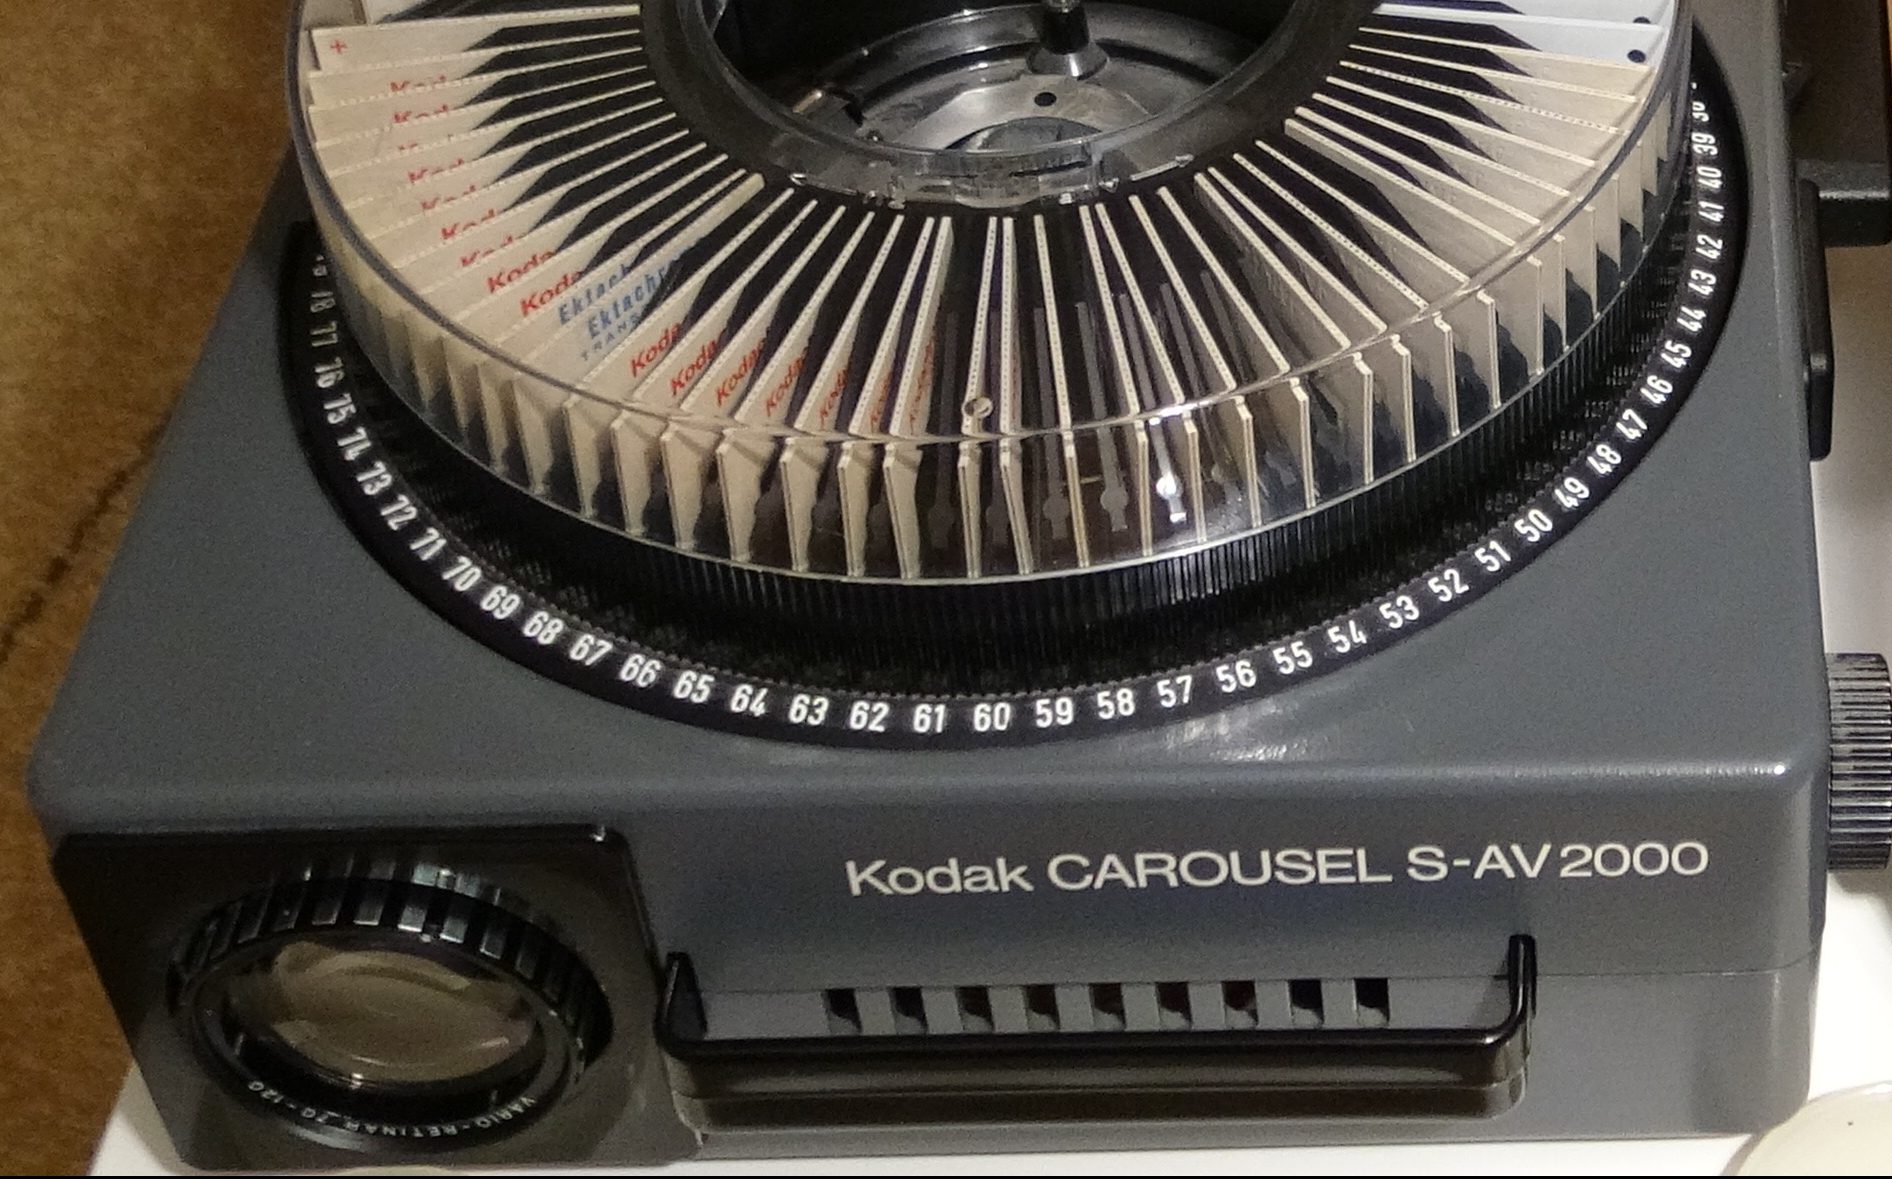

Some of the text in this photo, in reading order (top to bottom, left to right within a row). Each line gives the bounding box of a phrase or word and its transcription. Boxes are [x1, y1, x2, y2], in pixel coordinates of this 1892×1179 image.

[1691, 131, 1718, 156] 39
[1696, 165, 1723, 189] 40
[1698, 200, 1724, 222] 41
[1695, 234, 1723, 260] 42
[1687, 268, 1717, 296] 43
[1676, 306, 1707, 332] 44
[1660, 339, 1692, 369] 45
[1640, 374, 1673, 404] 46
[323, 393, 356, 424] 75
[1615, 408, 1648, 440] 47
[337, 426, 372, 461] 74
[1587, 443, 1622, 475] 48
[356, 461, 393, 496] 73
[1554, 476, 1590, 509] 49
[380, 494, 418, 531] 72
[1513, 508, 1553, 542] 50
[410, 527, 447, 561] 71
[1474, 540, 1511, 572] 51
[442, 555, 482, 592] 70
[1427, 568, 1470, 602] 52
[480, 585, 521, 620] 69
[1378, 595, 1420, 629] 53
[523, 610, 564, 645] 68
[1327, 619, 1367, 653] 54
[569, 633, 613, 666] 67
[1272, 640, 1313, 675] 55
[619, 653, 662, 688] 66
[673, 670, 715, 703] 65
[1215, 659, 1257, 693] 56
[730, 684, 768, 717] 64
[1096, 687, 1135, 720] 58
[1156, 674, 1193, 708] 57
[788, 693, 829, 726] 63
[849, 700, 890, 732] 62
[913, 703, 946, 733] 61
[973, 702, 1012, 732] 60
[1035, 696, 1074, 728] 59
[845, 857, 1035, 897] Kodak
[1046, 846, 1393, 892] CAROUSEL
